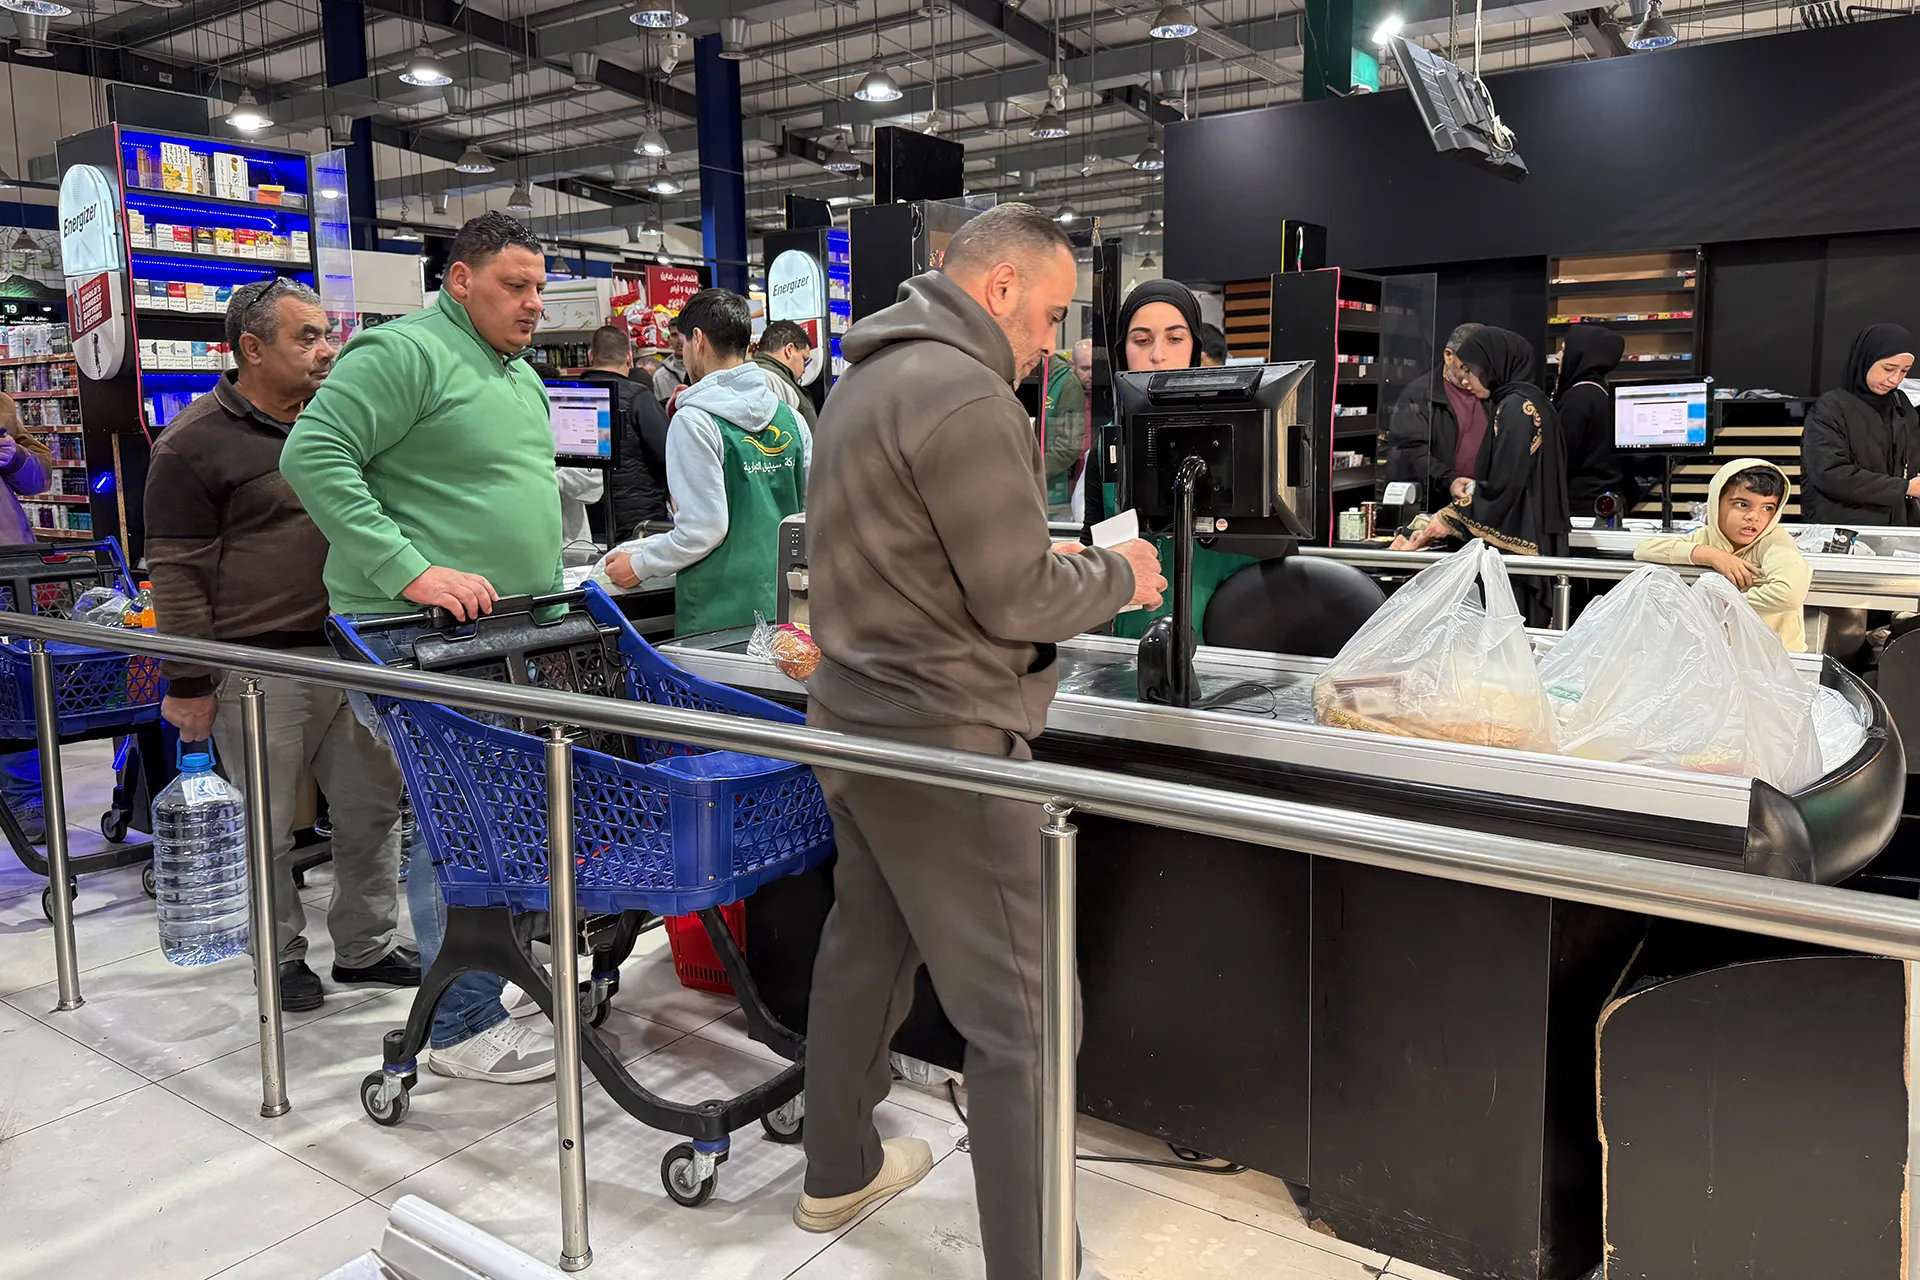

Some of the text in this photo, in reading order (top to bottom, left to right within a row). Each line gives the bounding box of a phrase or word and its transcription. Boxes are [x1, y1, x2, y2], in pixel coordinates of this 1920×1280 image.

[64, 203, 97, 238] Energizer
[773, 276, 809, 297] Energizer
[5, 304, 17, 314] 19
